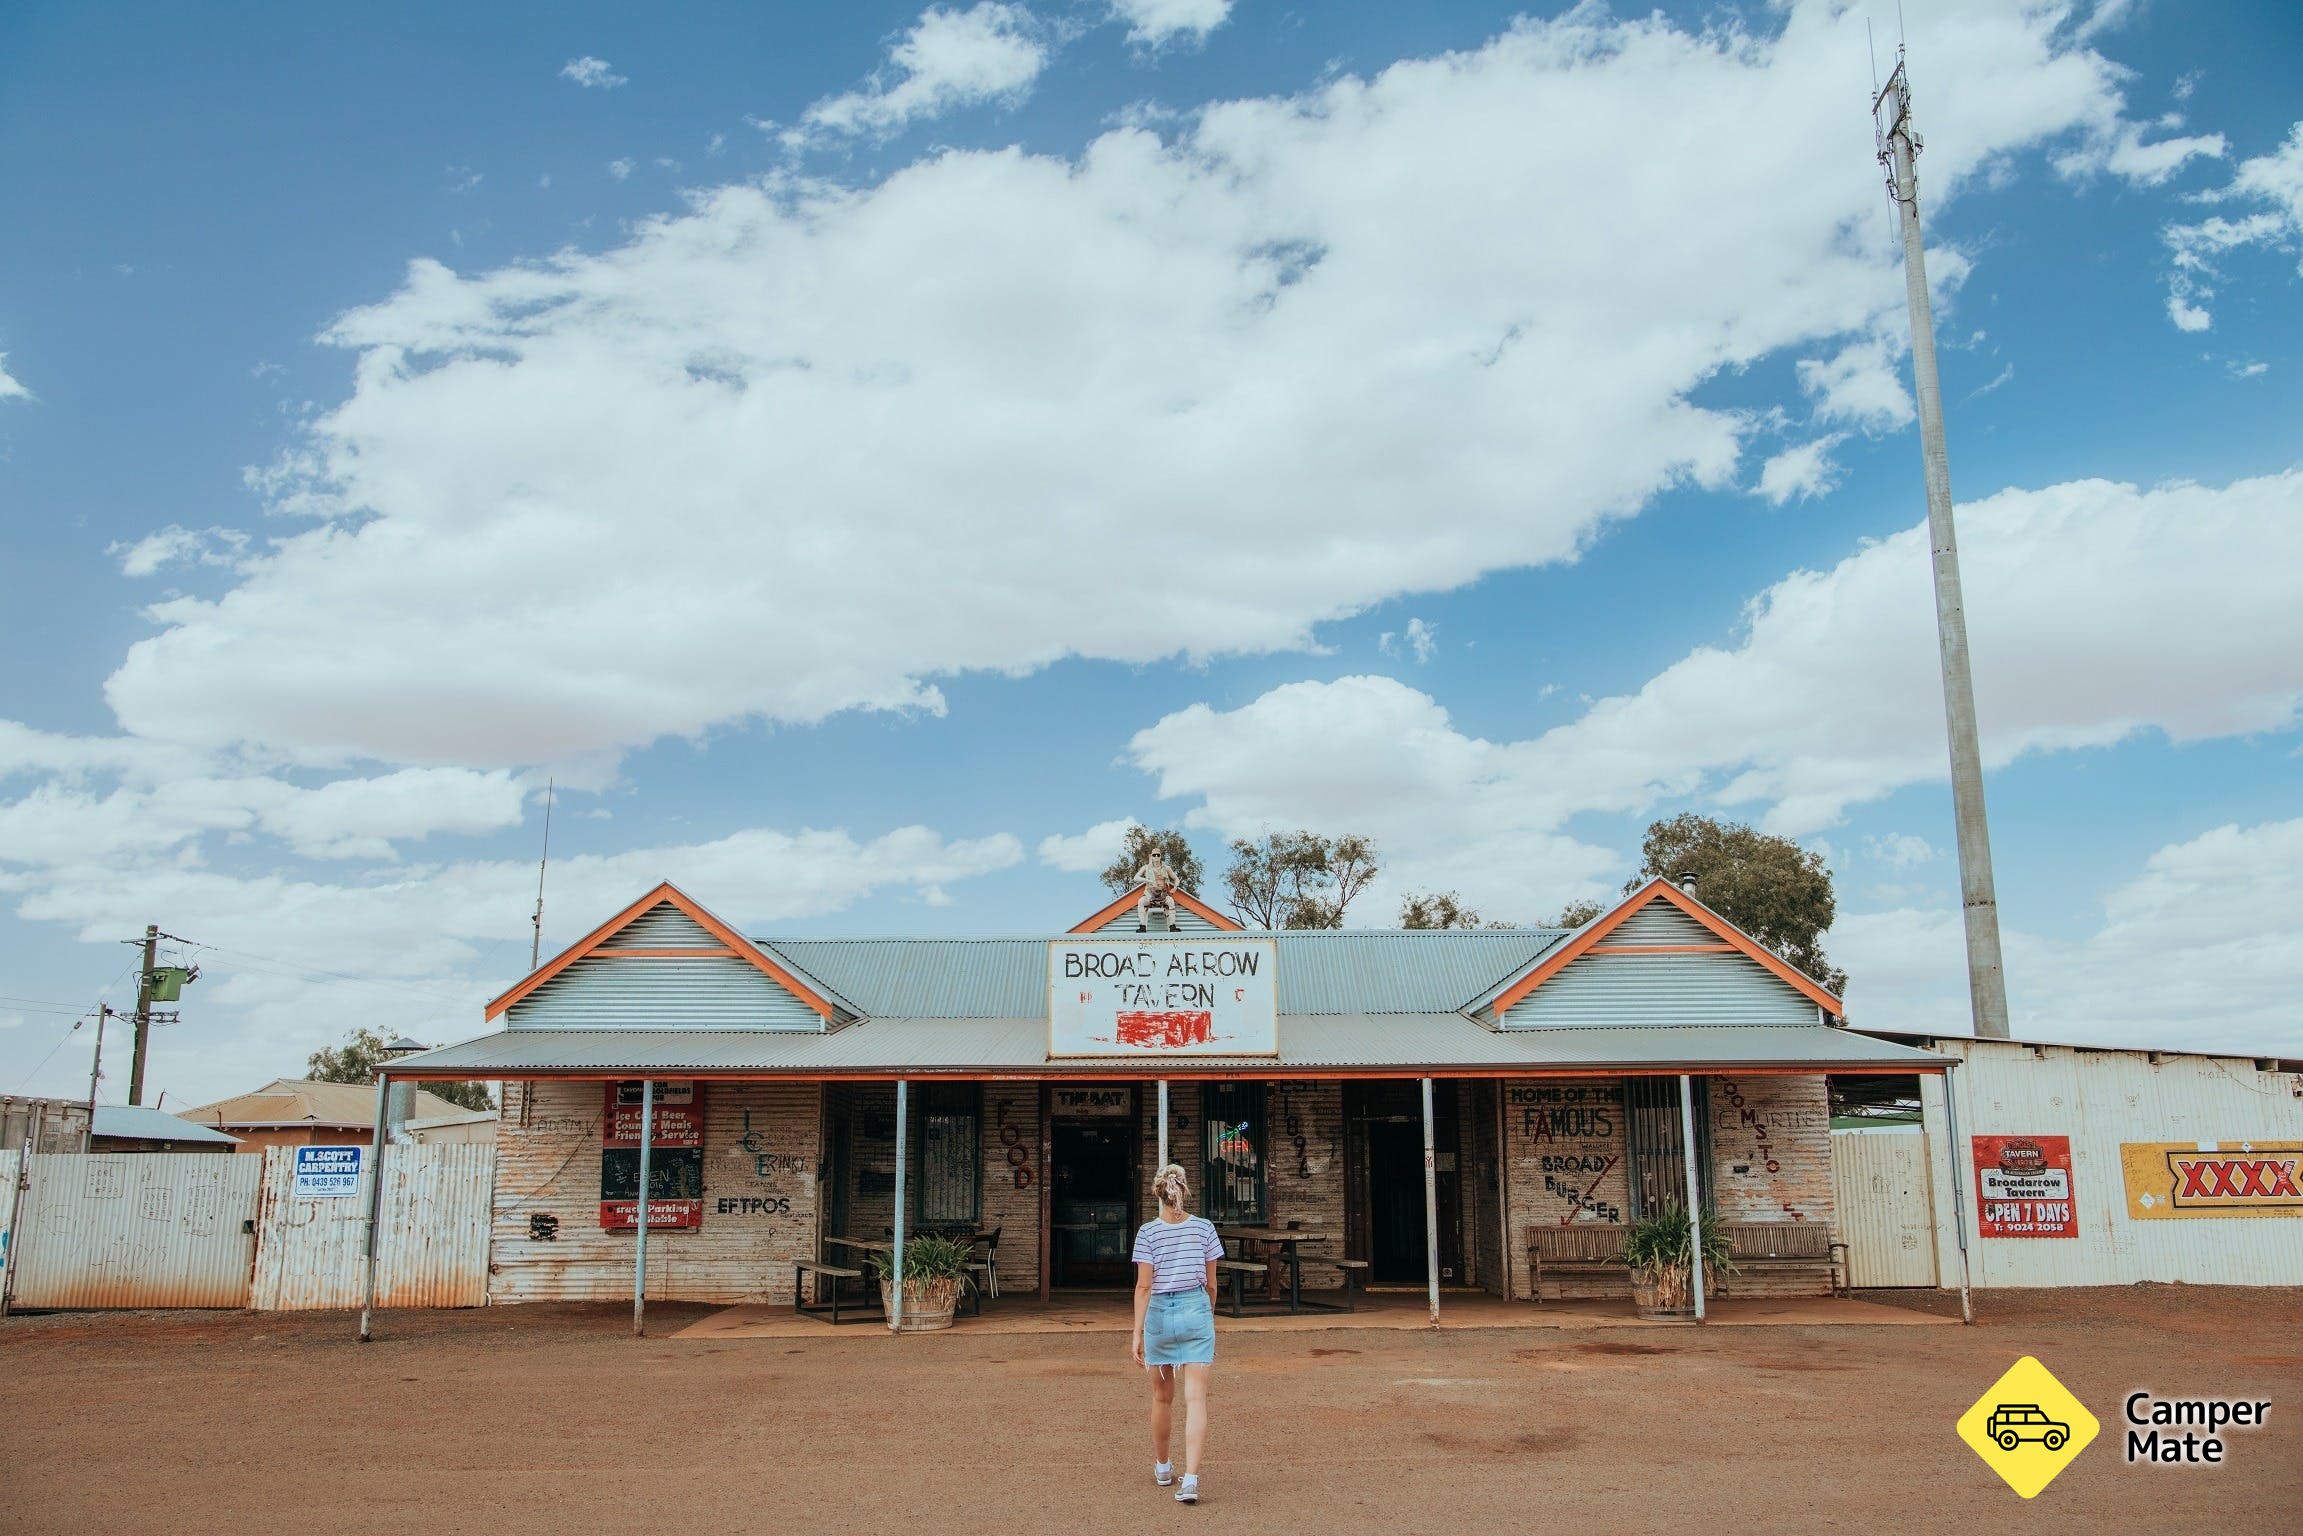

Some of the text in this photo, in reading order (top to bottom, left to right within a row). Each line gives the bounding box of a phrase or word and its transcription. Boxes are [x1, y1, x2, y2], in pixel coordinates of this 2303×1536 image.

[1065, 951, 1260, 978] BROAD ARROW
[1114, 983, 1215, 1009] TAVERN
[1511, 1087, 1561, 1102] HOME
[615, 1110, 686, 1121] Ice Cd Beer
[615, 1120, 692, 1131] Counr Meals
[1524, 1107, 1614, 1145] FAMOUS
[615, 1130, 700, 1142] Frieny Service
[997, 1100, 1034, 1190] FOOD
[1220, 1139, 1249, 1153] OPEN
[304, 1151, 354, 1162] M.SCOTT
[2004, 1150, 2039, 1158] TAVERN
[298, 1161, 359, 1173] CARPENTRY
[1542, 1155, 1620, 1173] BROADY
[300, 1177, 311, 1187] PH:
[312, 1177, 328, 1187] 0439
[342, 1177, 355, 1187] 967
[1988, 1178, 2061, 1188] Broadarrow
[2176, 1160, 2303, 1198] XXXX
[2005, 1188, 2046, 1198] Tavern
[717, 1198, 791, 1214] EFTPOS
[1984, 1203, 2071, 1223] OPEN 7 DAYS
[1994, 1223, 2064, 1232] T: 9024 2058
